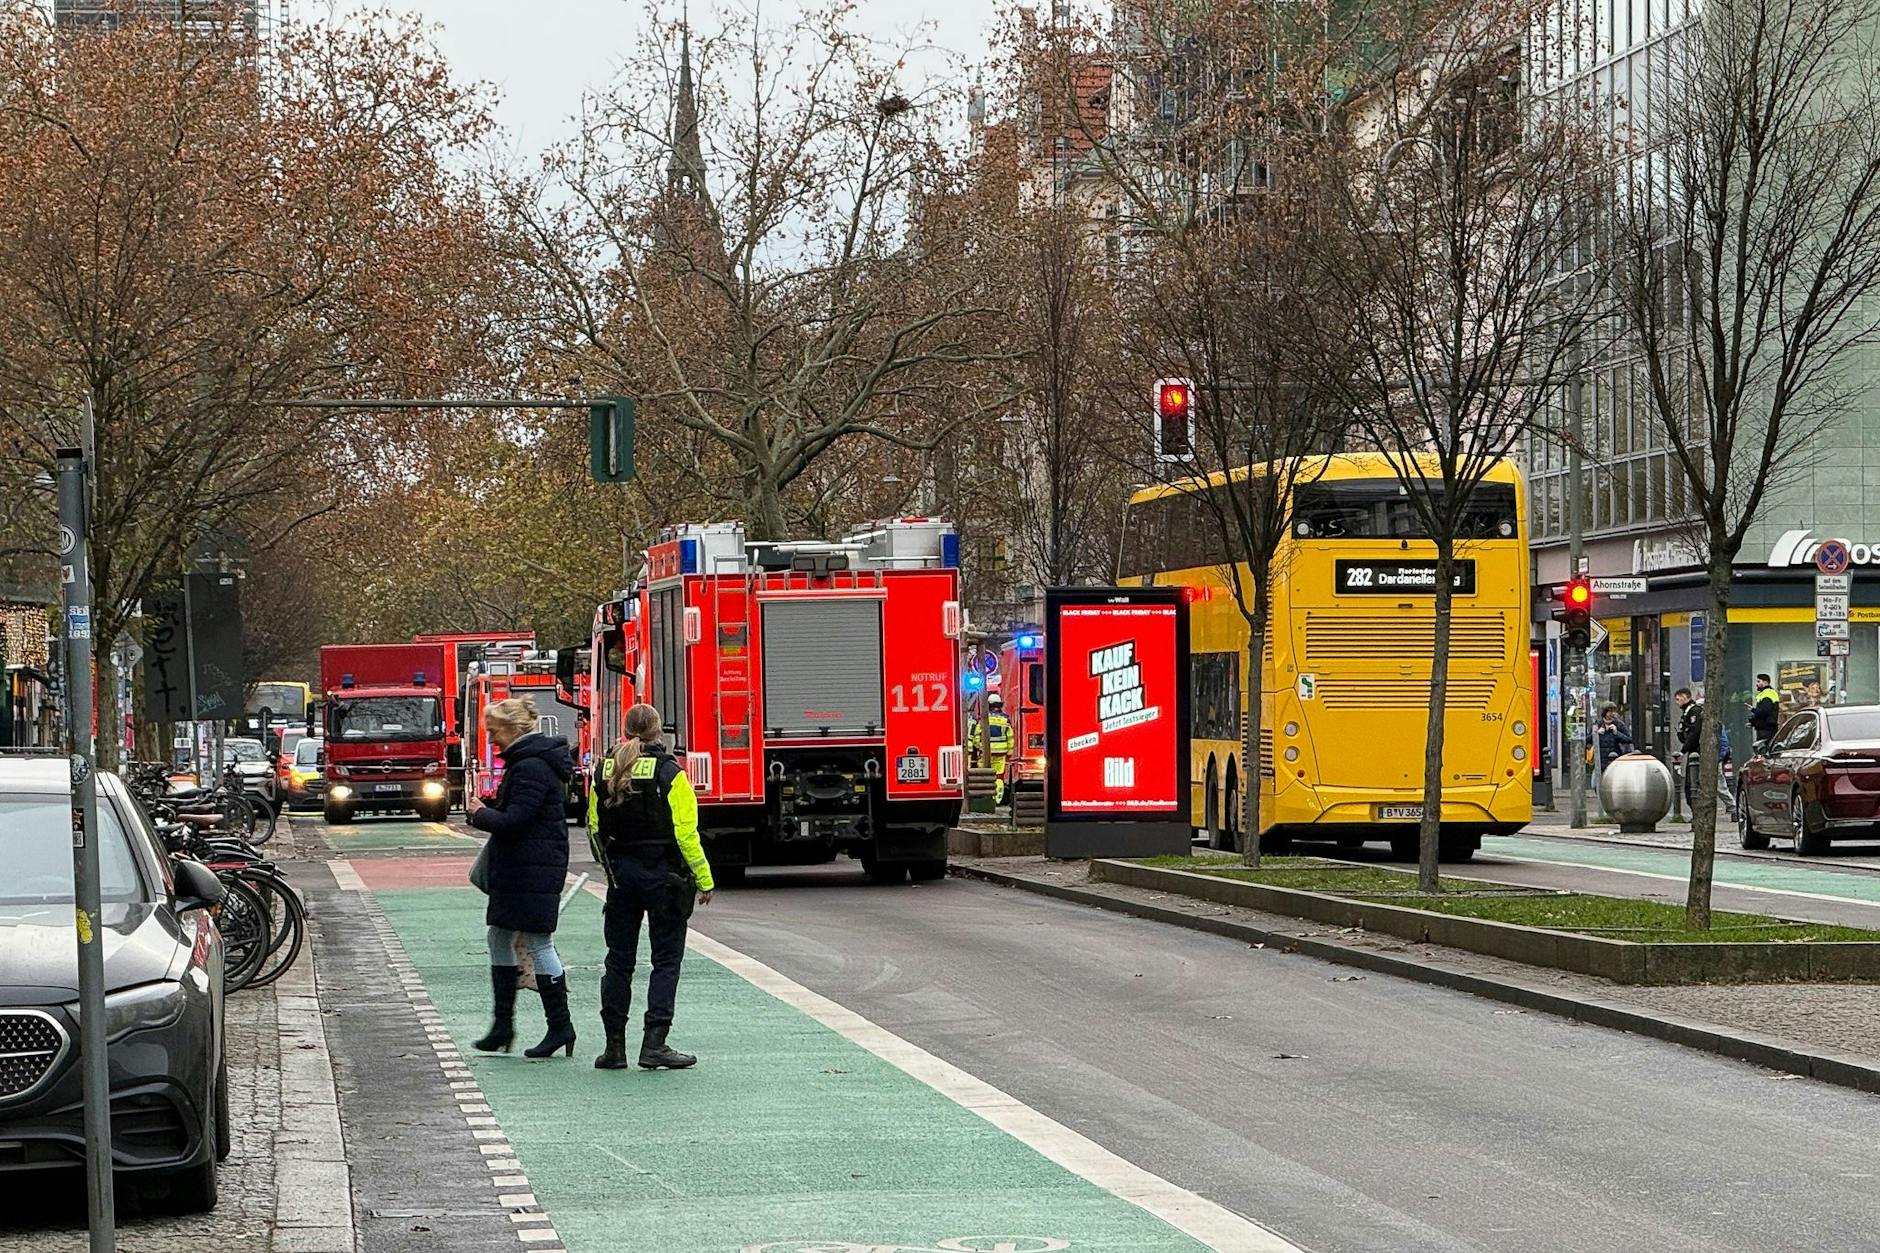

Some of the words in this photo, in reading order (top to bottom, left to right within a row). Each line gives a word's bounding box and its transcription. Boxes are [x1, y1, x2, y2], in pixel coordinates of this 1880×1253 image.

[1346, 568, 1373, 587] 282
[1593, 580, 1642, 589] Ahornstraße
[1091, 642, 1134, 676] KAUF
[911, 673, 948, 682] NOTRUF
[1102, 664, 1140, 696] KEIN
[891, 683, 949, 713] 112
[1099, 687, 1144, 720] KACK
[1122, 710, 1157, 725] Testsieger
[1481, 712, 1503, 721] 3654
[1069, 735, 1097, 749] checken
[603, 759, 655, 778] PZEI
[908, 758, 916, 769] B
[901, 768, 926, 779] 2881
[1386, 808, 1393, 817] B
